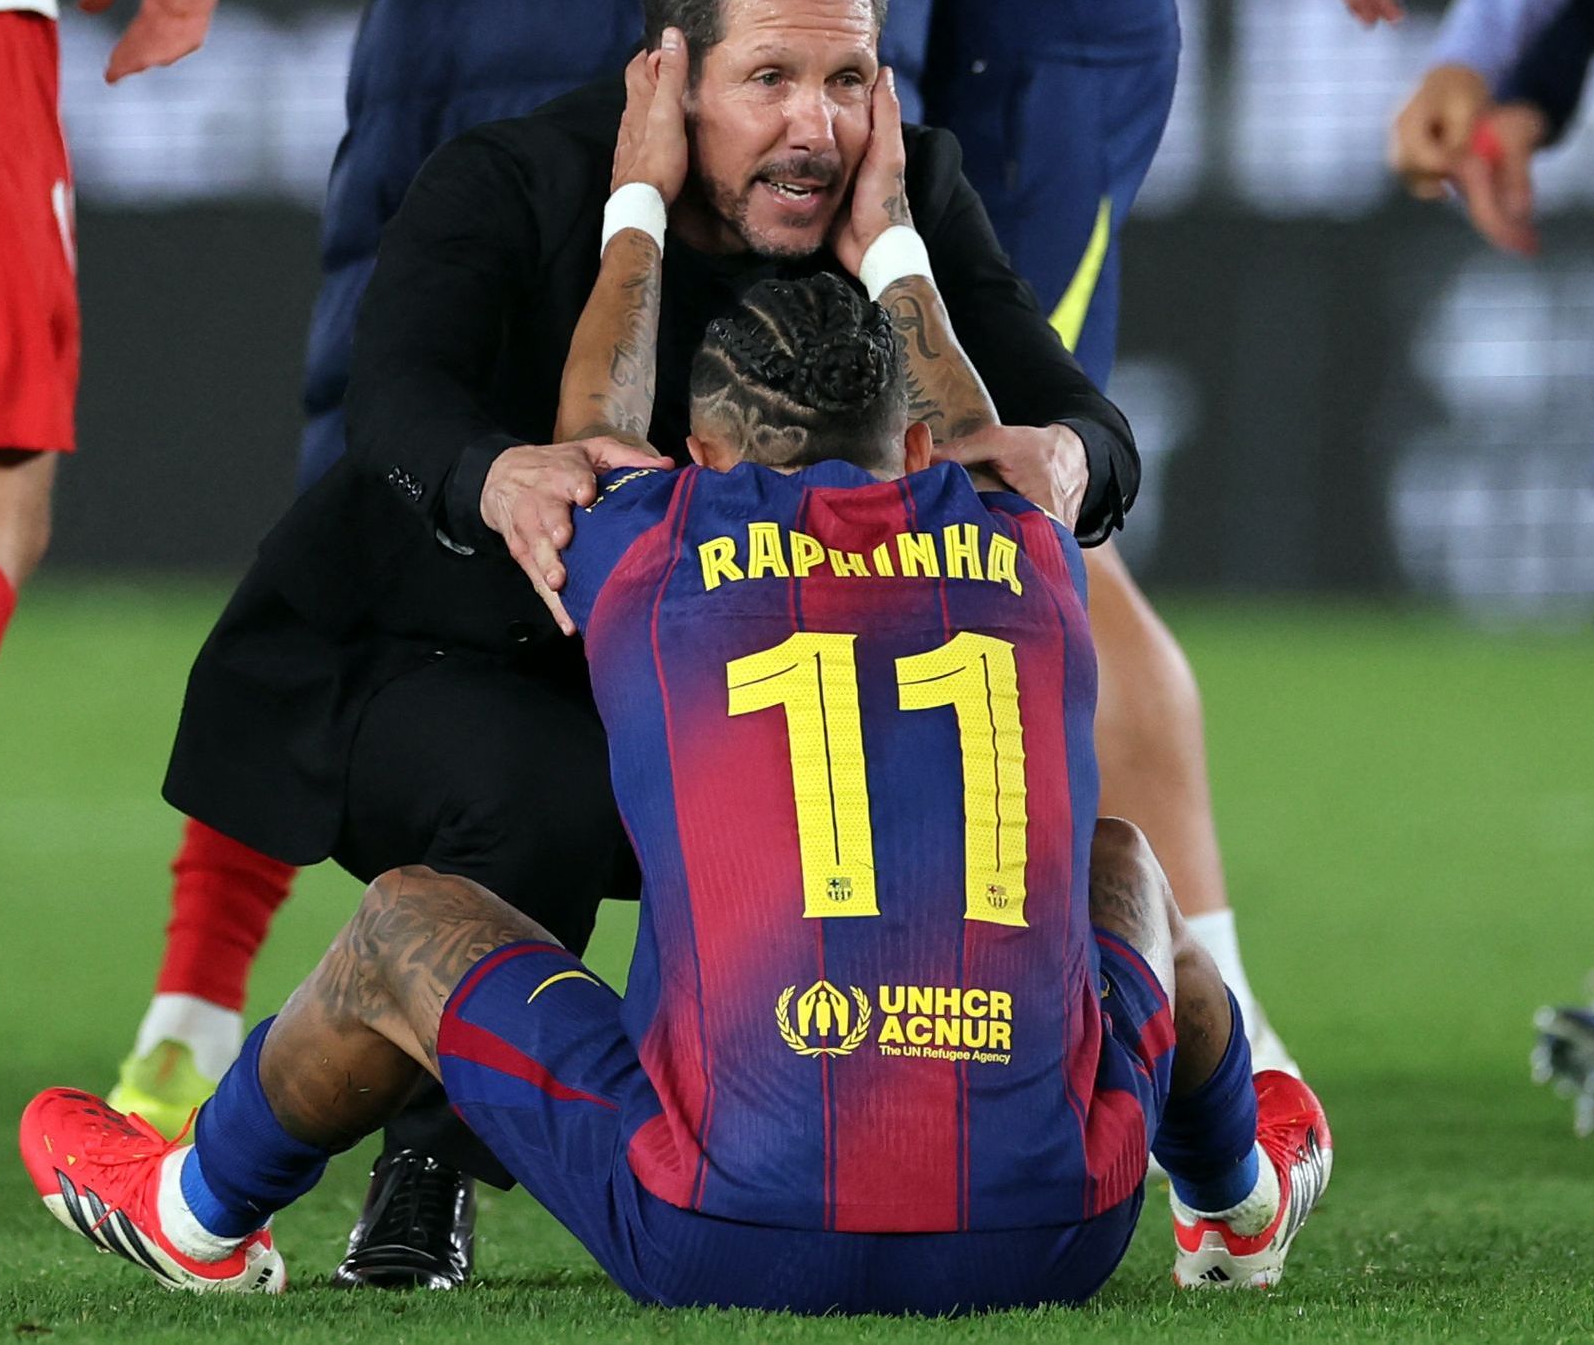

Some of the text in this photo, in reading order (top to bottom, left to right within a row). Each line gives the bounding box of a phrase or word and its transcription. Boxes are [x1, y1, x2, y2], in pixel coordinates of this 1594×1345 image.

[697, 522, 1023, 597] RAPHINHA
[726, 631, 1029, 927] 11
[879, 985, 1012, 1020] UNHCR
[878, 1015, 1011, 1050] ACNUR
[879, 1045, 1011, 1065] The UN Refugee Agency
